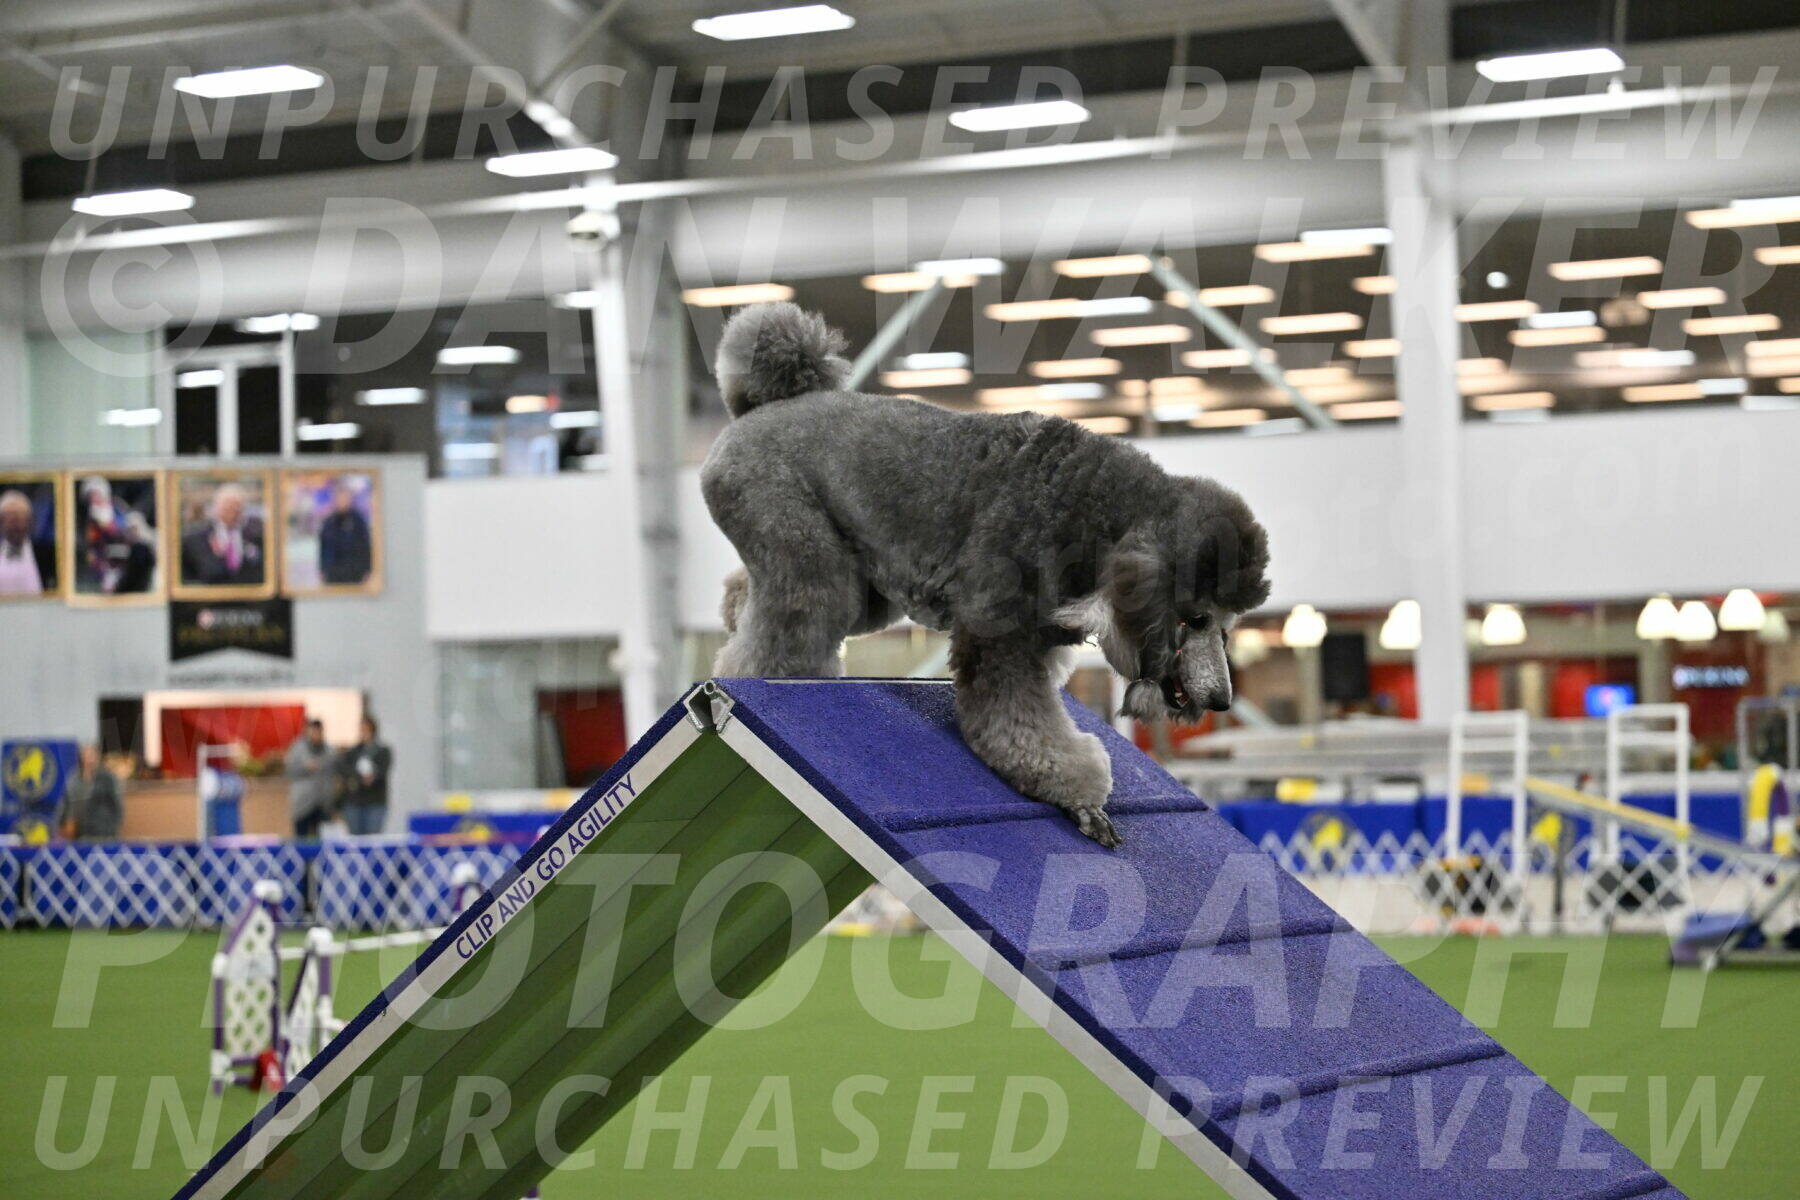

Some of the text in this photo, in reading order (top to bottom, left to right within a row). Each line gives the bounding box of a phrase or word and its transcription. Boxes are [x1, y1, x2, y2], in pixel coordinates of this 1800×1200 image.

[456, 773, 637, 960] CLIP AND GO AGILITY
